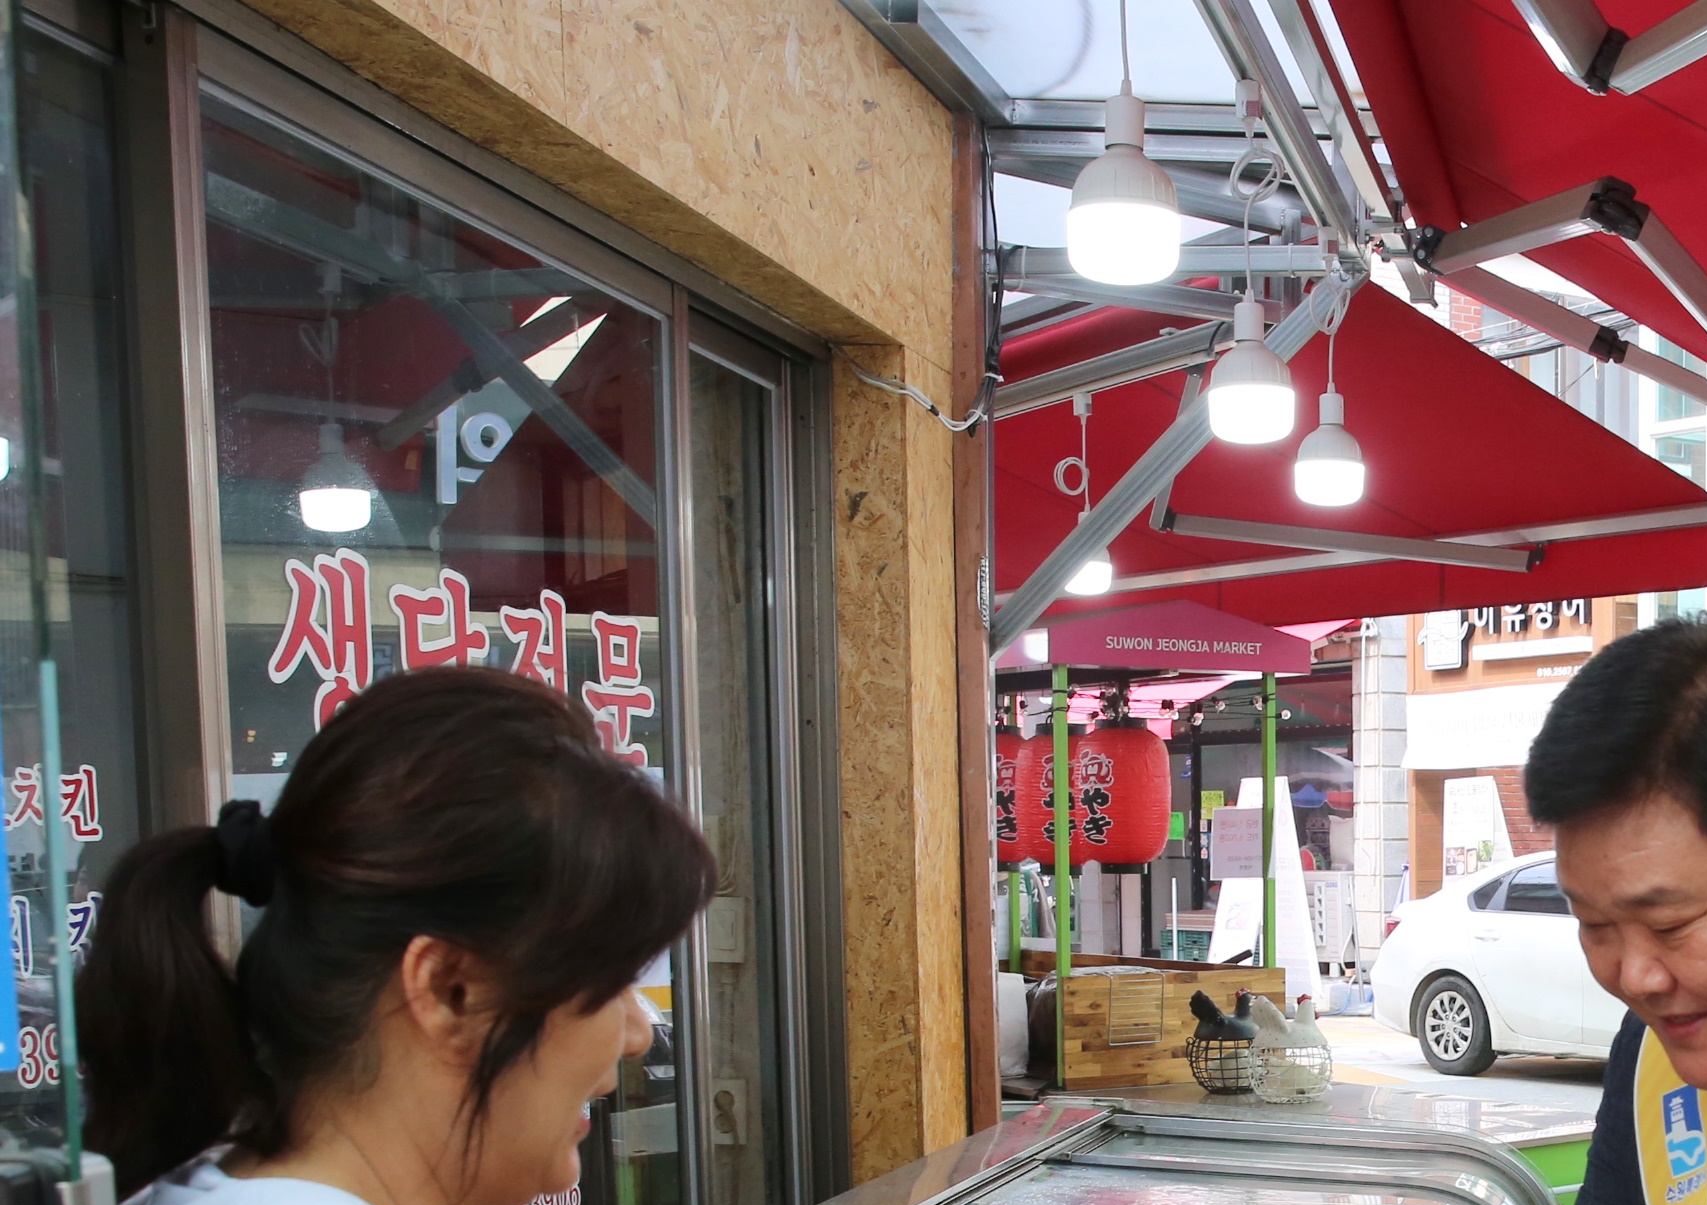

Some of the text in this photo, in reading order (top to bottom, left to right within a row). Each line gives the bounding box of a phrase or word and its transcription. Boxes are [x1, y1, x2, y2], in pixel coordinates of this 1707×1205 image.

[1105, 635, 1262, 655] SUWON JEONGJA MARKET
